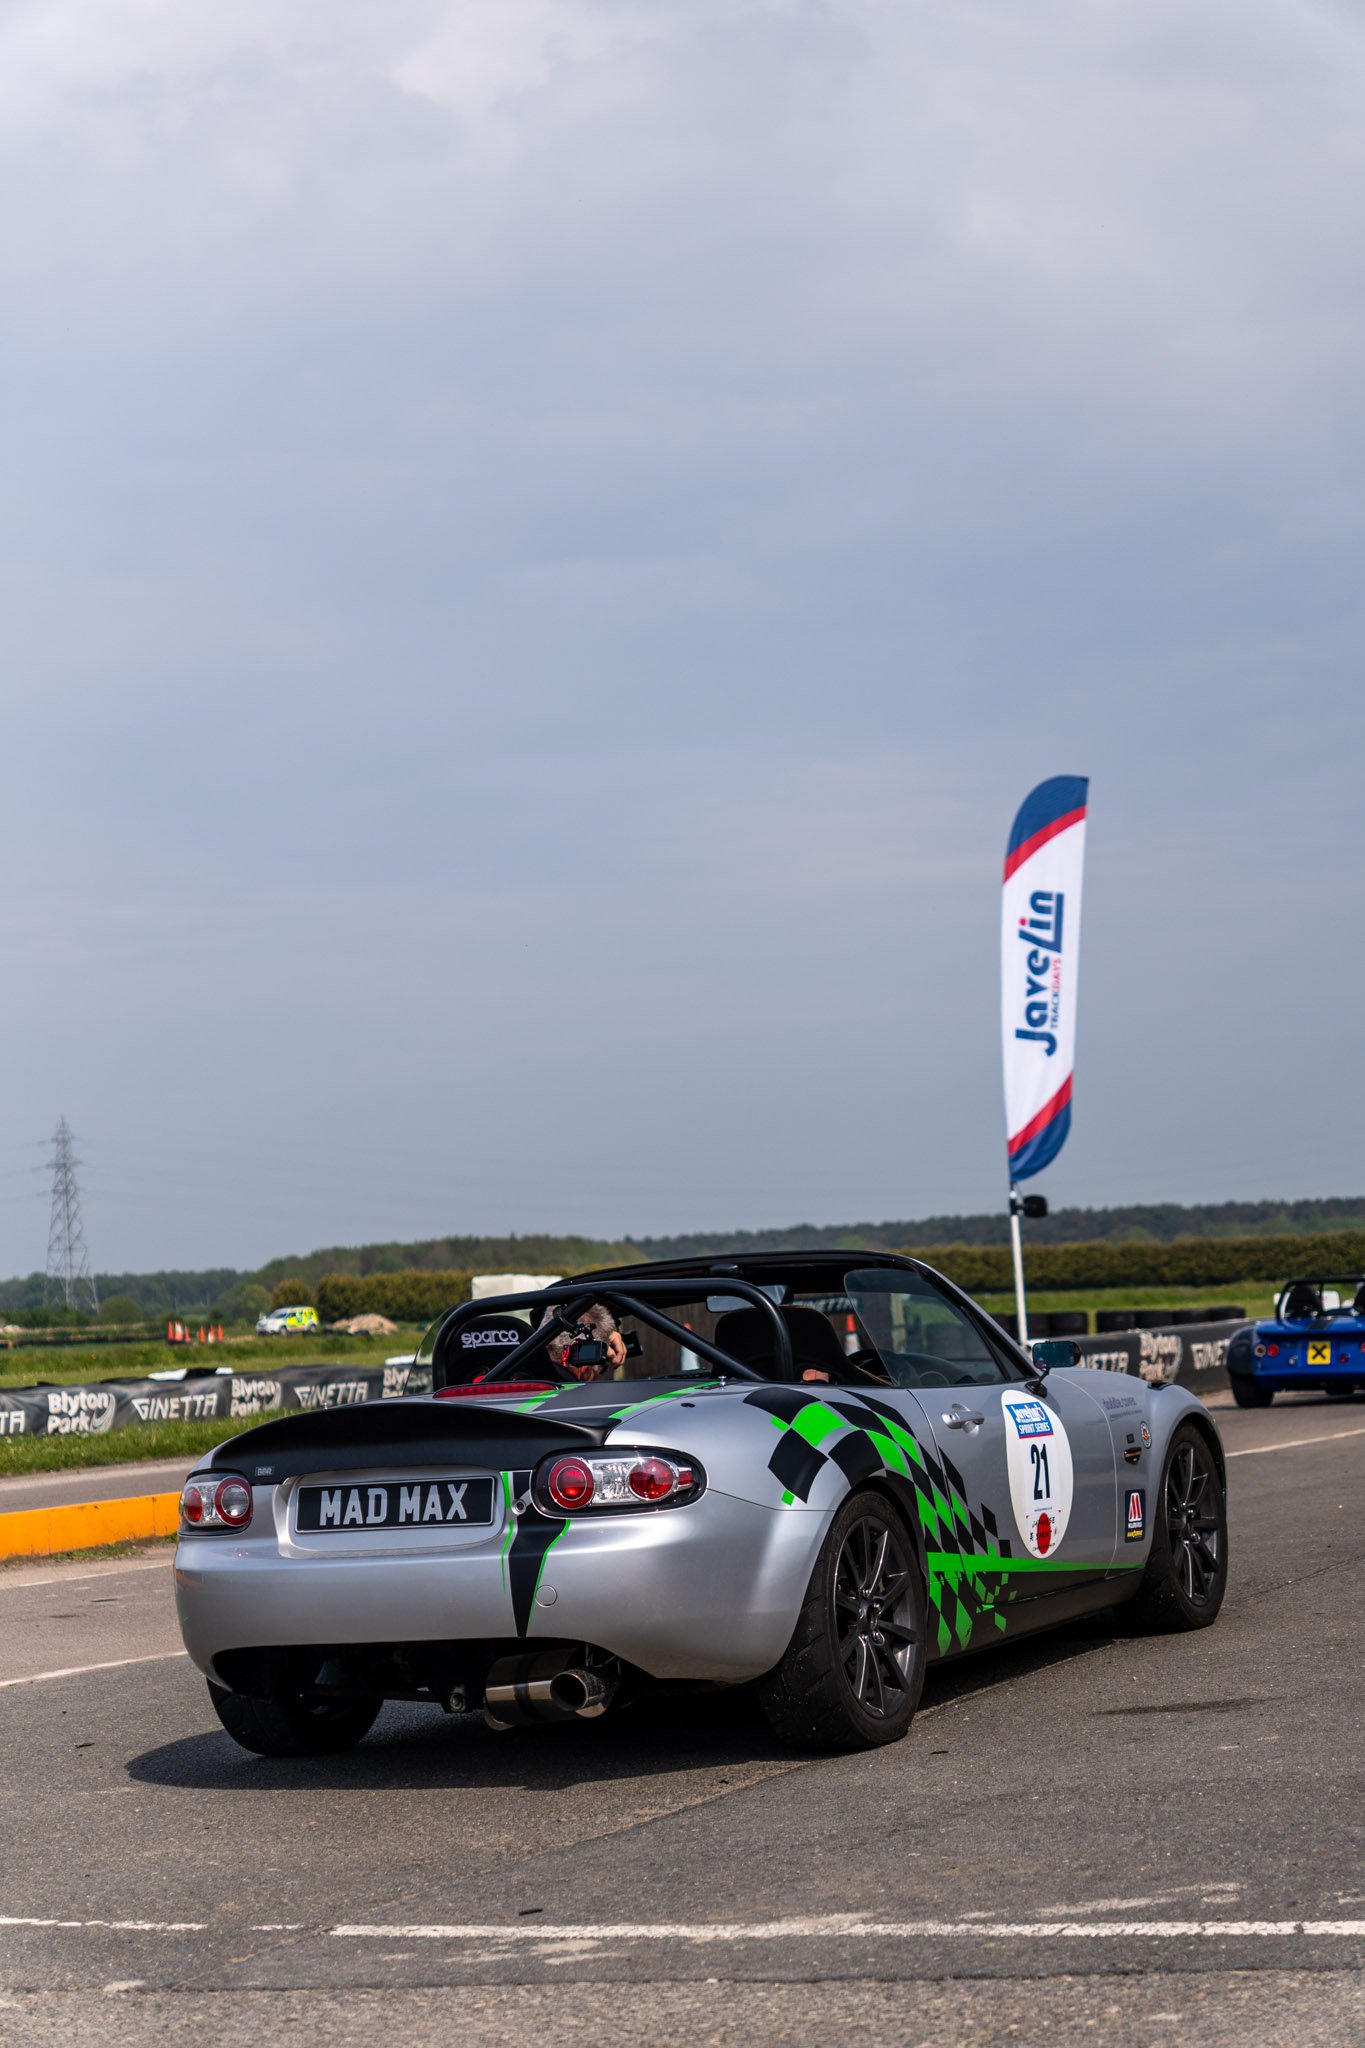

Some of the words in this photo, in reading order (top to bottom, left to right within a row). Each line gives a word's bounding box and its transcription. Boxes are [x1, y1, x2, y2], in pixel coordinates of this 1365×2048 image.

[1015, 889, 1064, 1057] Javelin
[1051, 957, 1062, 1029] TRACKDAYS
[461, 1329, 519, 1348] sparco
[231, 1378, 276, 1402] Blyton
[294, 1381, 369, 1409] GINETTA
[47, 1391, 109, 1417] Blyton
[132, 1393, 218, 1420] GINETTA
[230, 1397, 261, 1417] Park
[47, 1411, 91, 1435] Park
[1018, 1422, 1035, 1434] SPRINT
[1035, 1421, 1050, 1432] SERIES
[1030, 1443, 1051, 1500] 21
[319, 1487, 389, 1527] MAD
[398, 1482, 469, 1523] MAX
